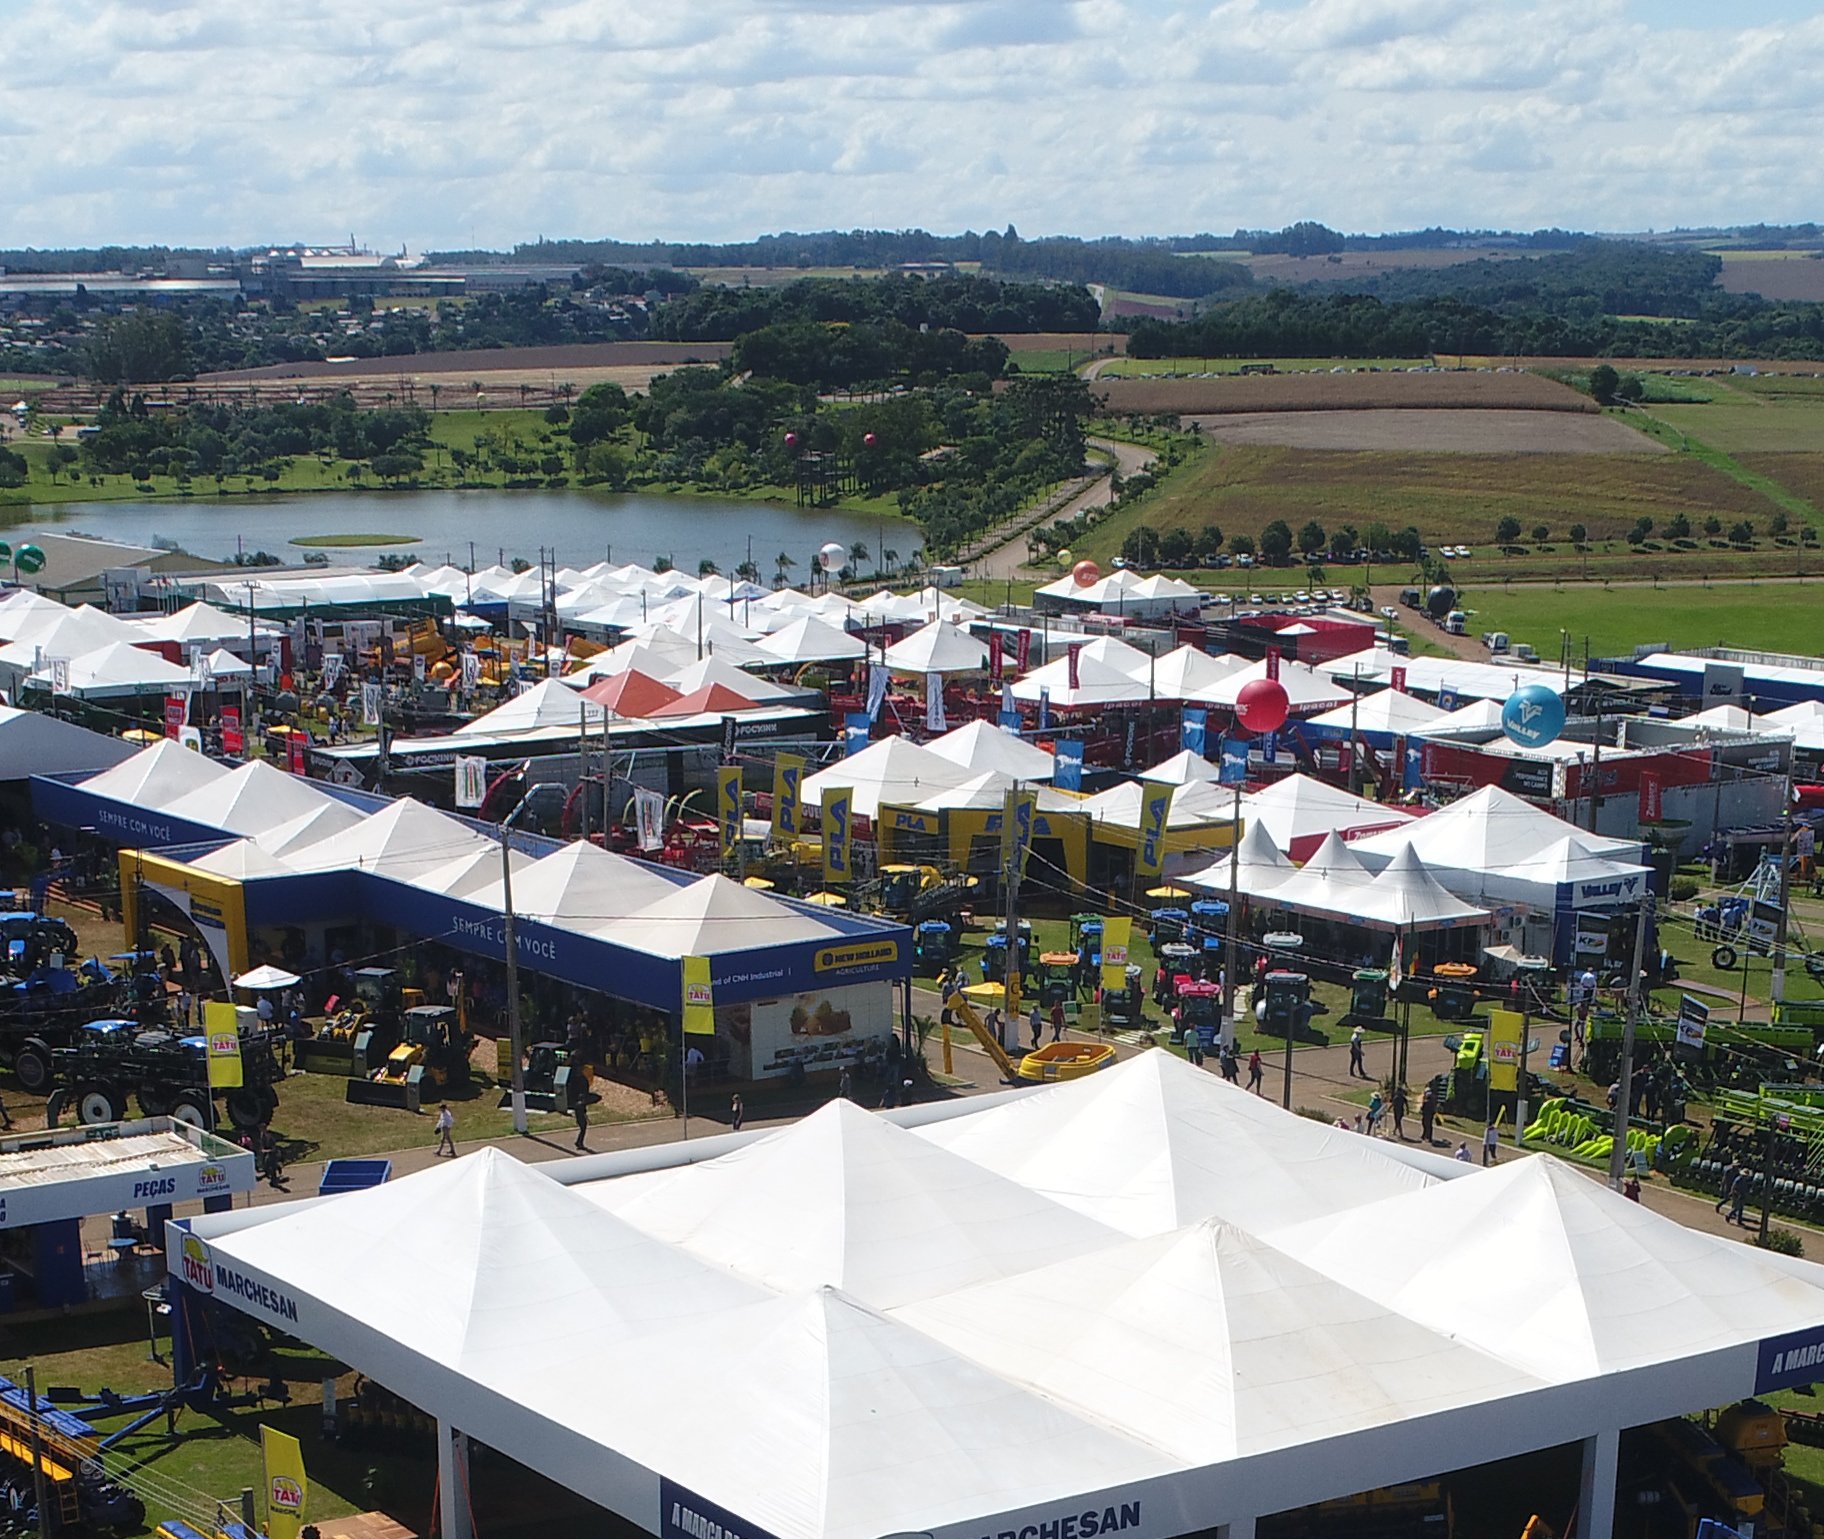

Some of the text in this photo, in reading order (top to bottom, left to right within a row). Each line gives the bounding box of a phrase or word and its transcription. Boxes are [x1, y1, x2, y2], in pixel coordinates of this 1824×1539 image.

[725, 777, 740, 845] PLA
[780, 767, 799, 834] PLA
[98, 810, 172, 841] SEMPRE COM VOCÊ
[895, 814, 926, 831] PLA
[984, 814, 1053, 836] PA
[1143, 795, 1169, 868] PLA
[829, 799, 848, 872] PLA
[1581, 882, 1623, 898] VALLEY
[452, 915, 557, 960] SEMPRE CM VOCÊ
[835, 947, 893, 963] NEW HOLLAND
[1106, 951, 1128, 961] TATU
[724, 977, 732, 985] of
[732, 975, 749, 984] CNH
[750, 969, 784, 982] Industrial
[1009, 981, 1019, 995] C
[689, 990, 711, 1001] TATU
[133, 1177, 176, 1200] PEÇAS
[201, 1173, 225, 1184] TATU
[184, 1254, 213, 1290] TATU
[216, 1264, 299, 1323] MARCHESAN
[1772, 1352, 1783, 1374] A
[272, 1487, 301, 1504] TATU
[671, 1502, 681, 1526] A
